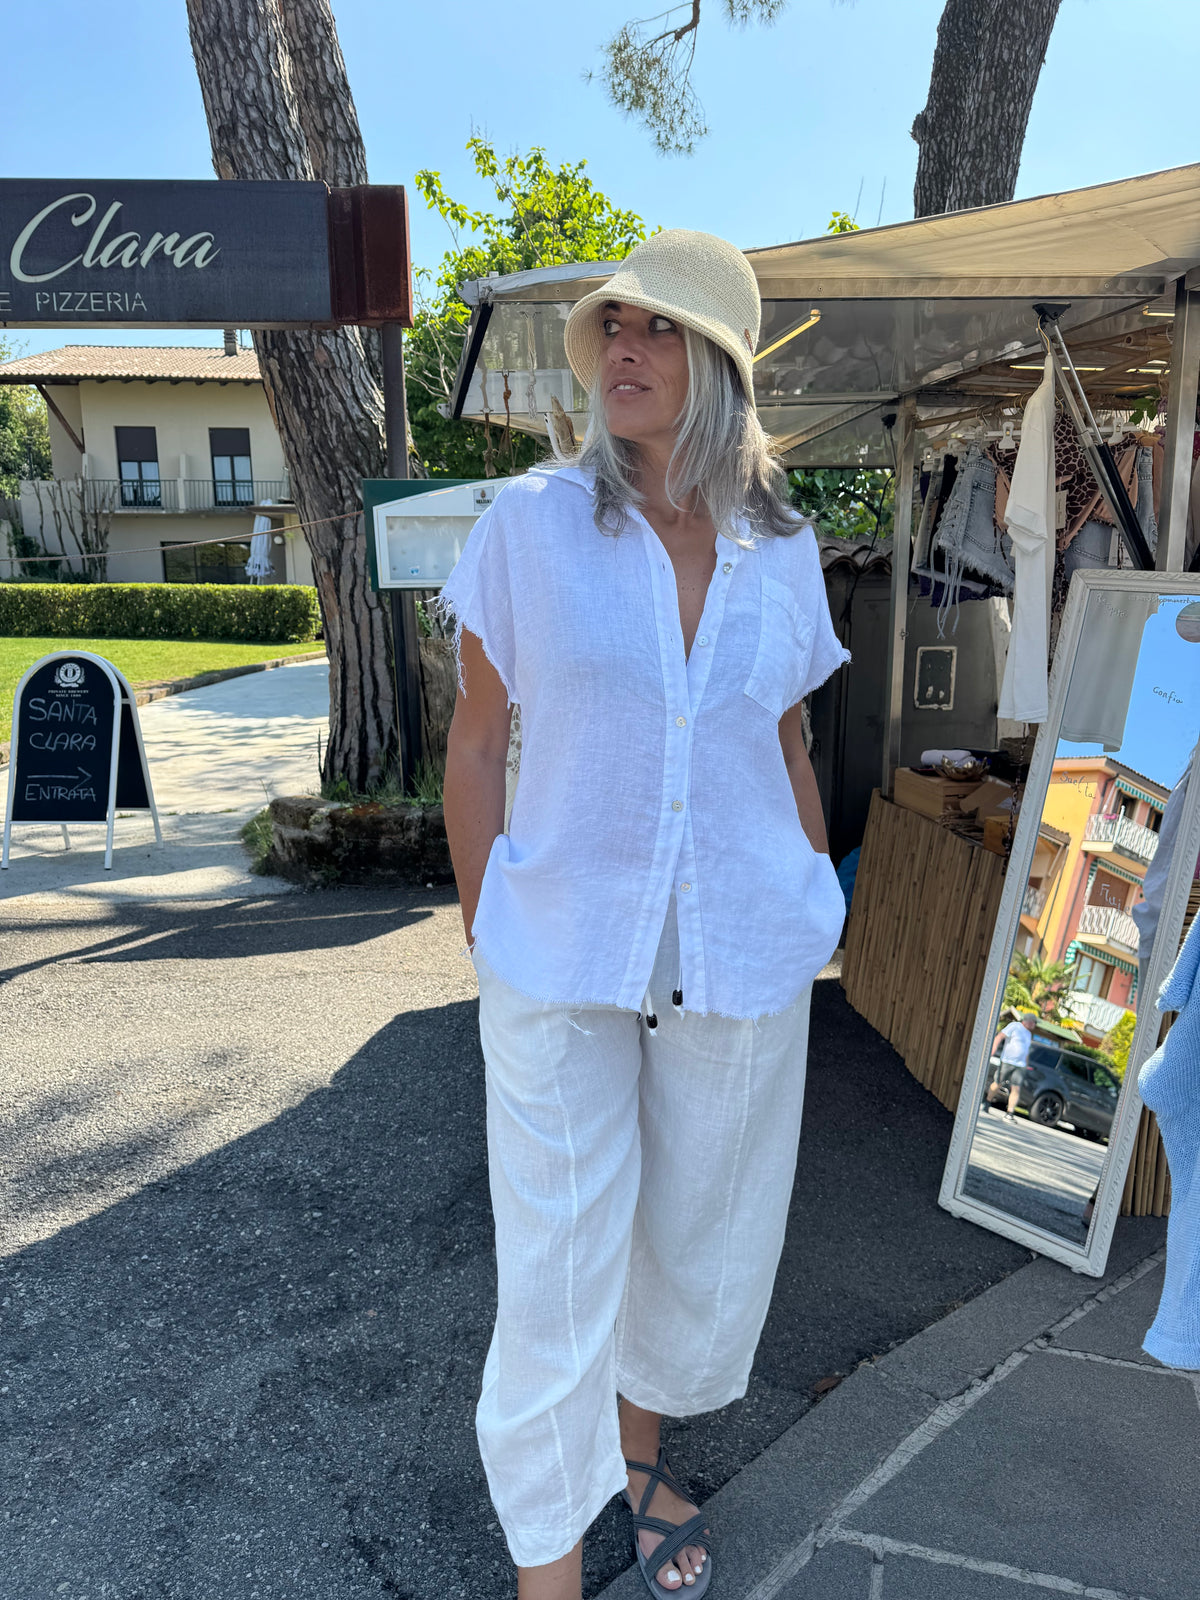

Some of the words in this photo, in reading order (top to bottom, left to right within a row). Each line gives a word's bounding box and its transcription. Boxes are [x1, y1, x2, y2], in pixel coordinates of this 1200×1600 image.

[10, 192, 221, 283] Clara
[35, 291, 147, 313] PIZZERIA
[28, 698, 98, 725] SANTA
[29, 732, 97, 751] CLARA
[25, 783, 97, 802] ENTRATA
